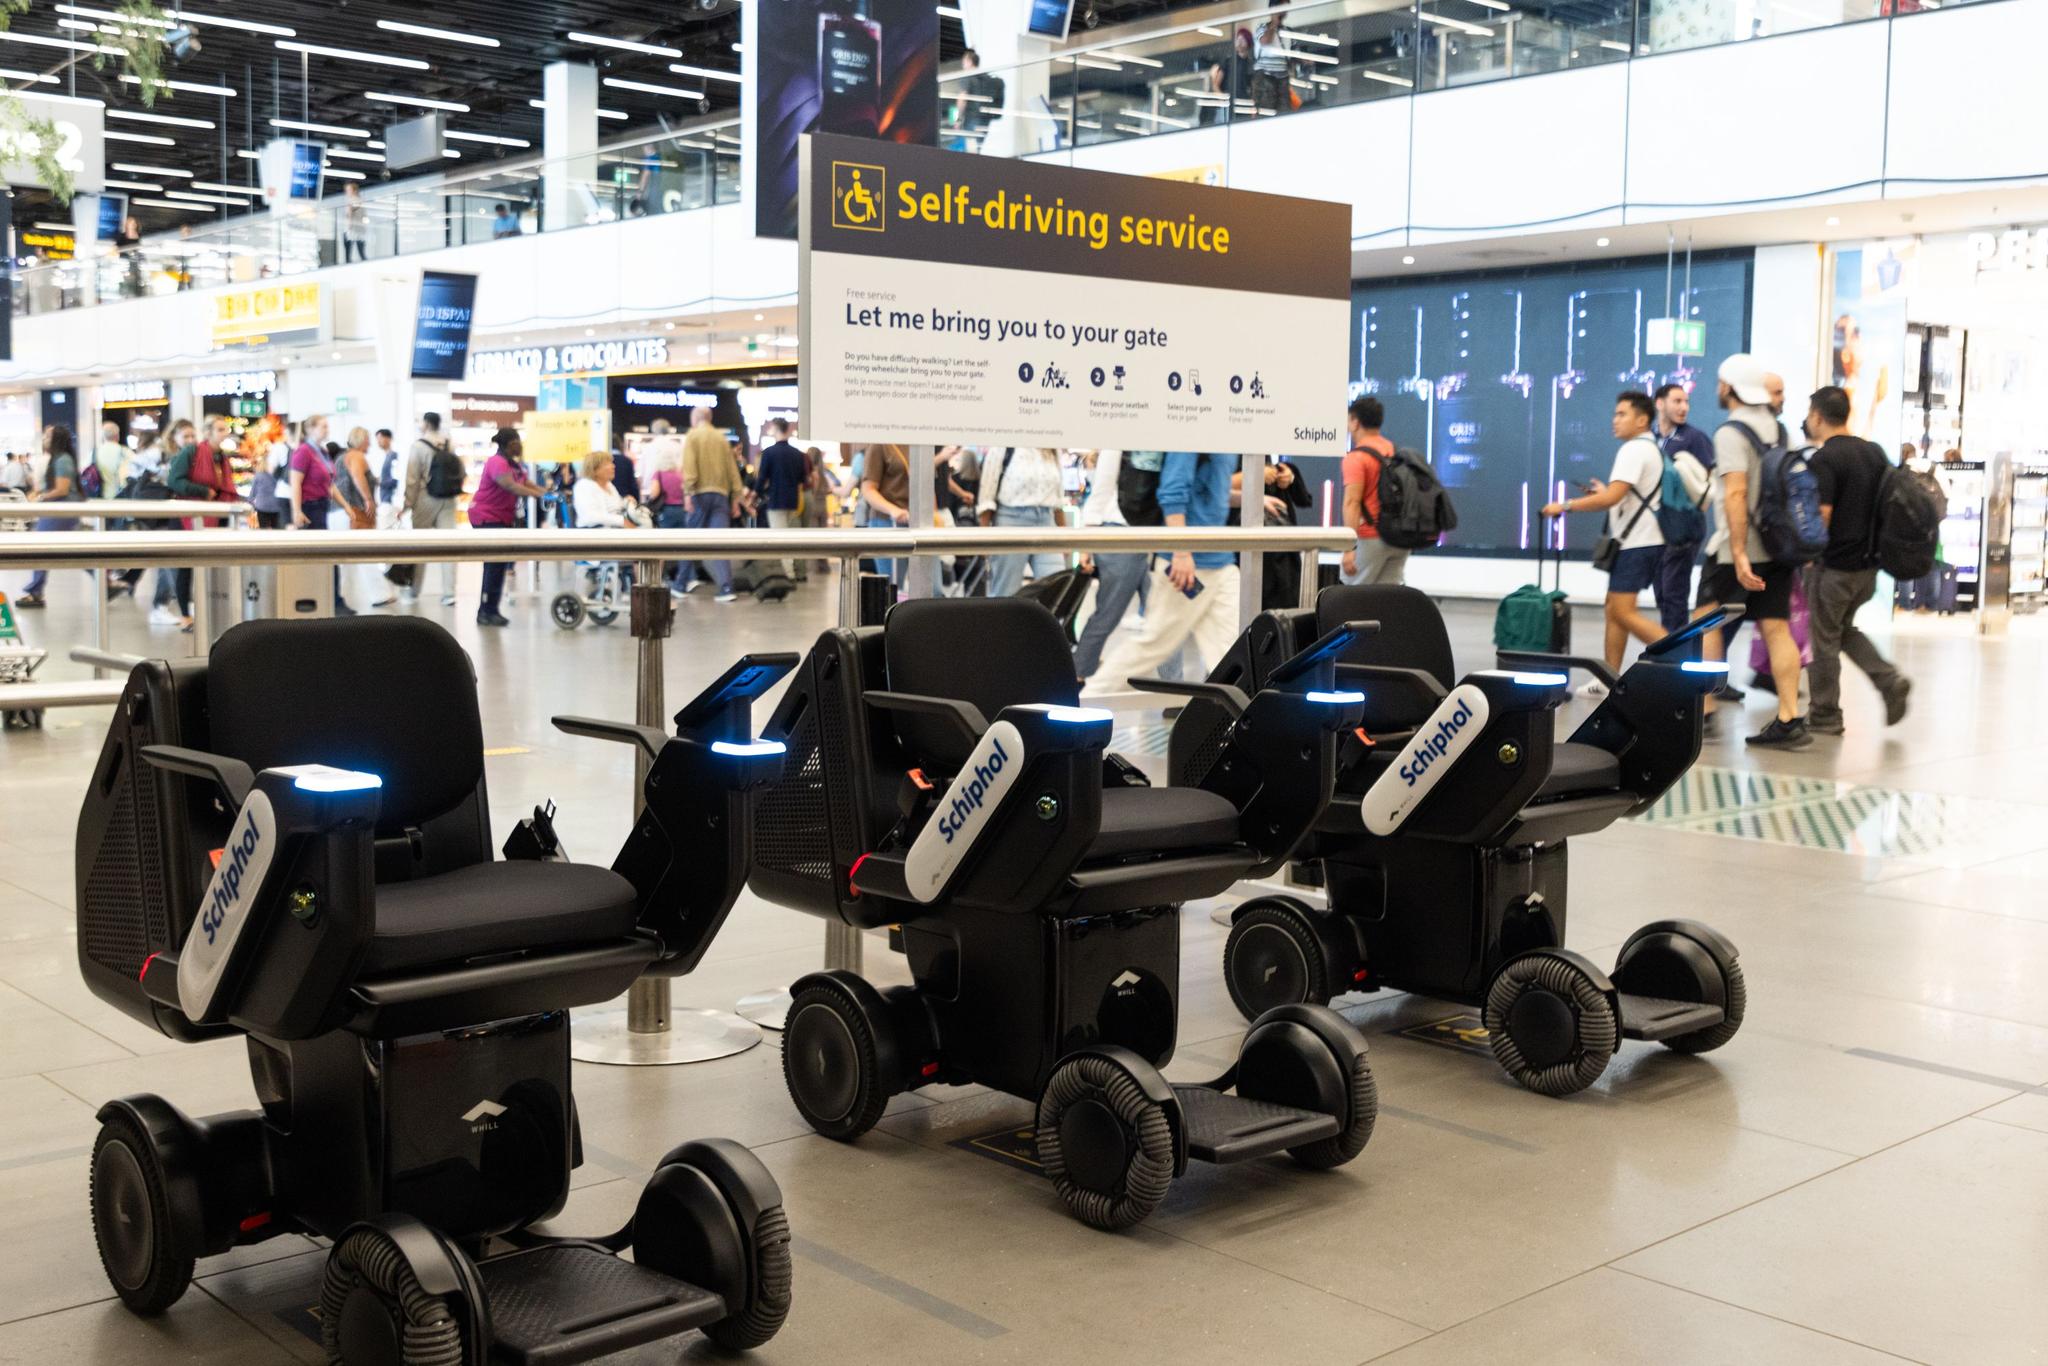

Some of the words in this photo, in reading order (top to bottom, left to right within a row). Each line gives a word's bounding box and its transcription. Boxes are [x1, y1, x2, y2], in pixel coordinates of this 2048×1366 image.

[54, 120, 85, 172] 2
[897, 180, 1109, 250] Self-driving
[1119, 213, 1230, 254] service
[846, 287, 865, 299] Free
[867, 289, 897, 301] service
[846, 302, 882, 327] Let
[889, 311, 924, 330] me
[932, 307, 991, 341] bring
[997, 319, 1037, 342] you
[1043, 319, 1066, 340] to
[1072, 324, 1119, 347] your
[1124, 327, 1168, 350] gate
[545, 347, 559, 370] &
[561, 338, 669, 369] CHOCOLATES
[845, 351, 855, 360] Do
[857, 354, 870, 362] you
[872, 353, 888, 361] have
[890, 354, 919, 364] difficulty
[922, 356, 951, 367] walking?
[953, 358, 963, 366] Let
[965, 358, 975, 367] the
[844, 363, 870, 374] driving
[872, 365, 908, 373] wheelchair
[910, 367, 929, 377] bring
[930, 369, 943, 377] you
[944, 369, 952, 377] to
[953, 370, 968, 379] your
[1019, 396, 1033, 404] Take
[1040, 397, 1053, 405] seat
[1294, 427, 1337, 443] Schiphol
[1399, 698, 1473, 788] Schiphol
[938, 737, 1008, 845] Schiphol
[202, 809, 260, 946] Schiphol
[471, 1121, 499, 1134] WHILL
